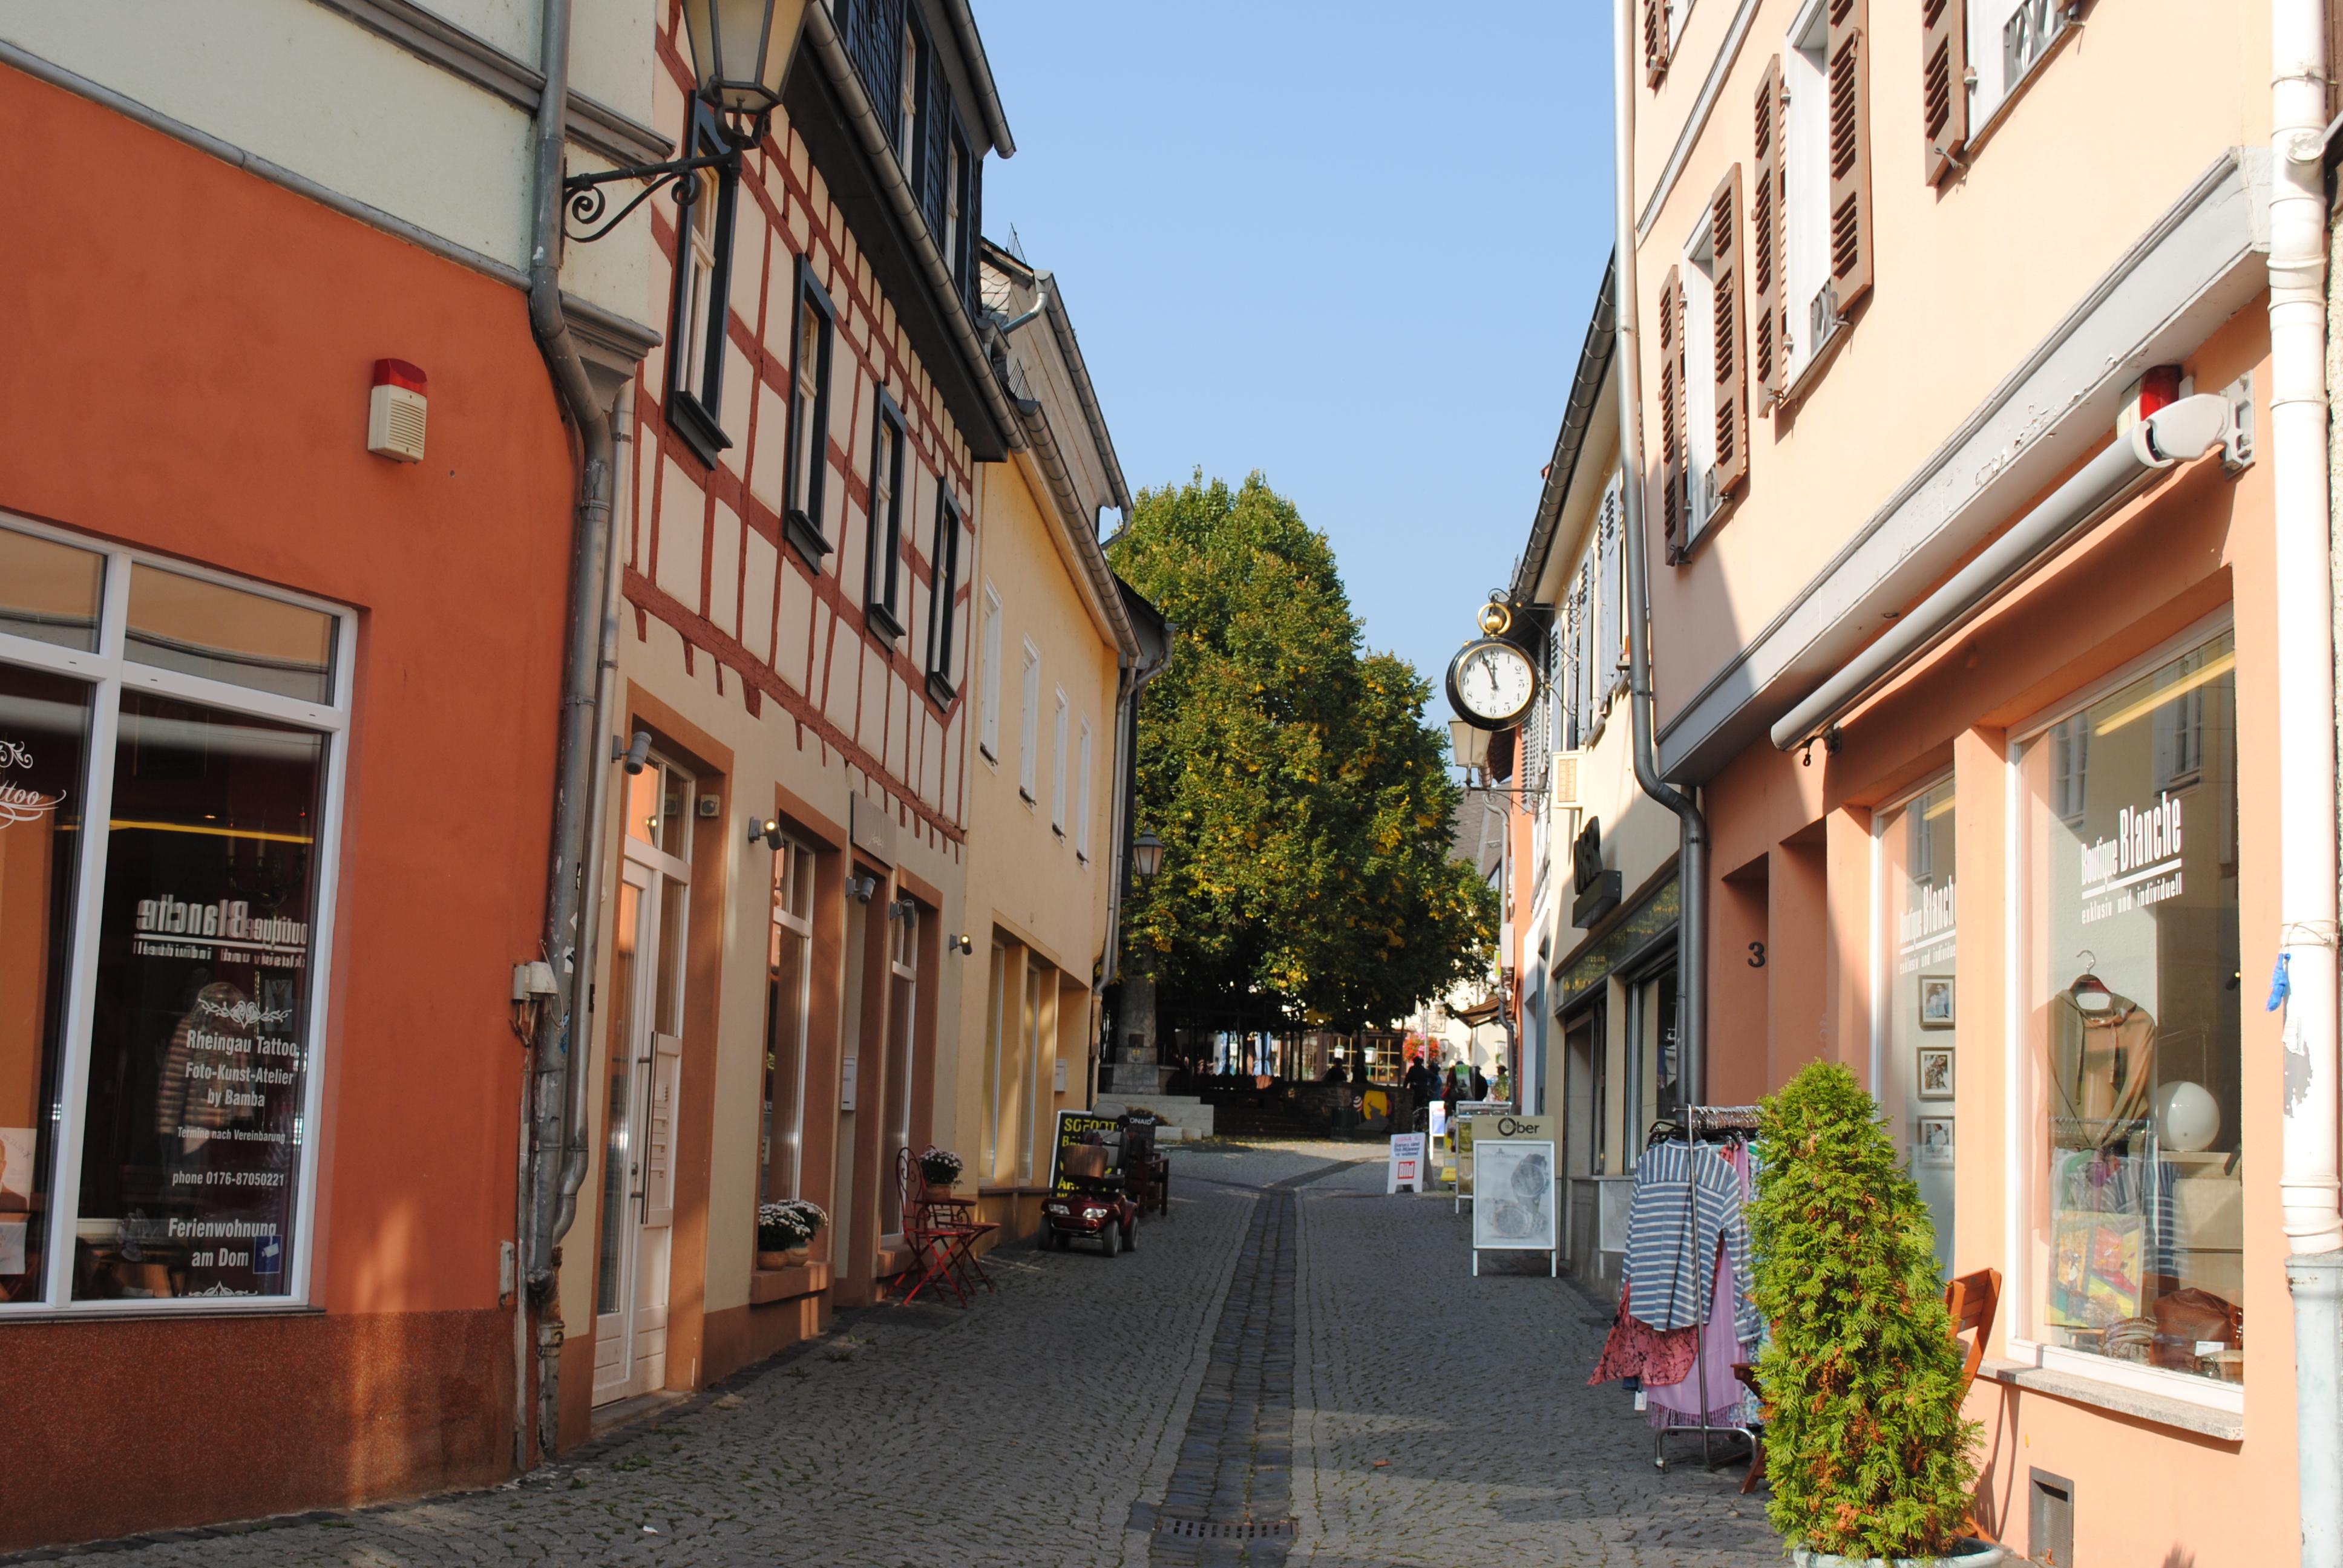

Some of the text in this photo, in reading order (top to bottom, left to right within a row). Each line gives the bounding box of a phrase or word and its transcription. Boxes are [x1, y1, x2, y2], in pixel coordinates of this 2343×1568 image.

[1467, 664, 1475, 673] 10
[1515, 665, 1521, 675] 2
[1463, 677, 1469, 686] 9
[1518, 679, 1525, 688] 3
[1466, 691, 1473, 700] 8
[1514, 693, 1520, 702] 4
[1476, 701, 1483, 710] 7
[1490, 705, 1496, 714] 6
[1504, 702, 1510, 711] 5
[2081, 791, 2181, 888] Boutique Blanche
[1923, 875, 1956, 935] Blanch
[2082, 872, 2182, 924] exklusiv und individuell
[1748, 941, 1765, 967] 3
[1921, 949, 1930, 967] und
[1933, 941, 1956, 964] individue
[186, 1030, 297, 1057] Rheingau Tattoo
[185, 1062, 294, 1085] Foto-Kunst-Atelier
[207, 1088, 265, 1108] by Bamba
[177, 1126, 286, 1145] Termine nach Vereinbarung
[1497, 1117, 1540, 1137] Ober
[172, 1171, 284, 1186] phone 0176-87050221
[168, 1218, 277, 1238] Ferienwohnung
[192, 1247, 249, 1267] am Dom
